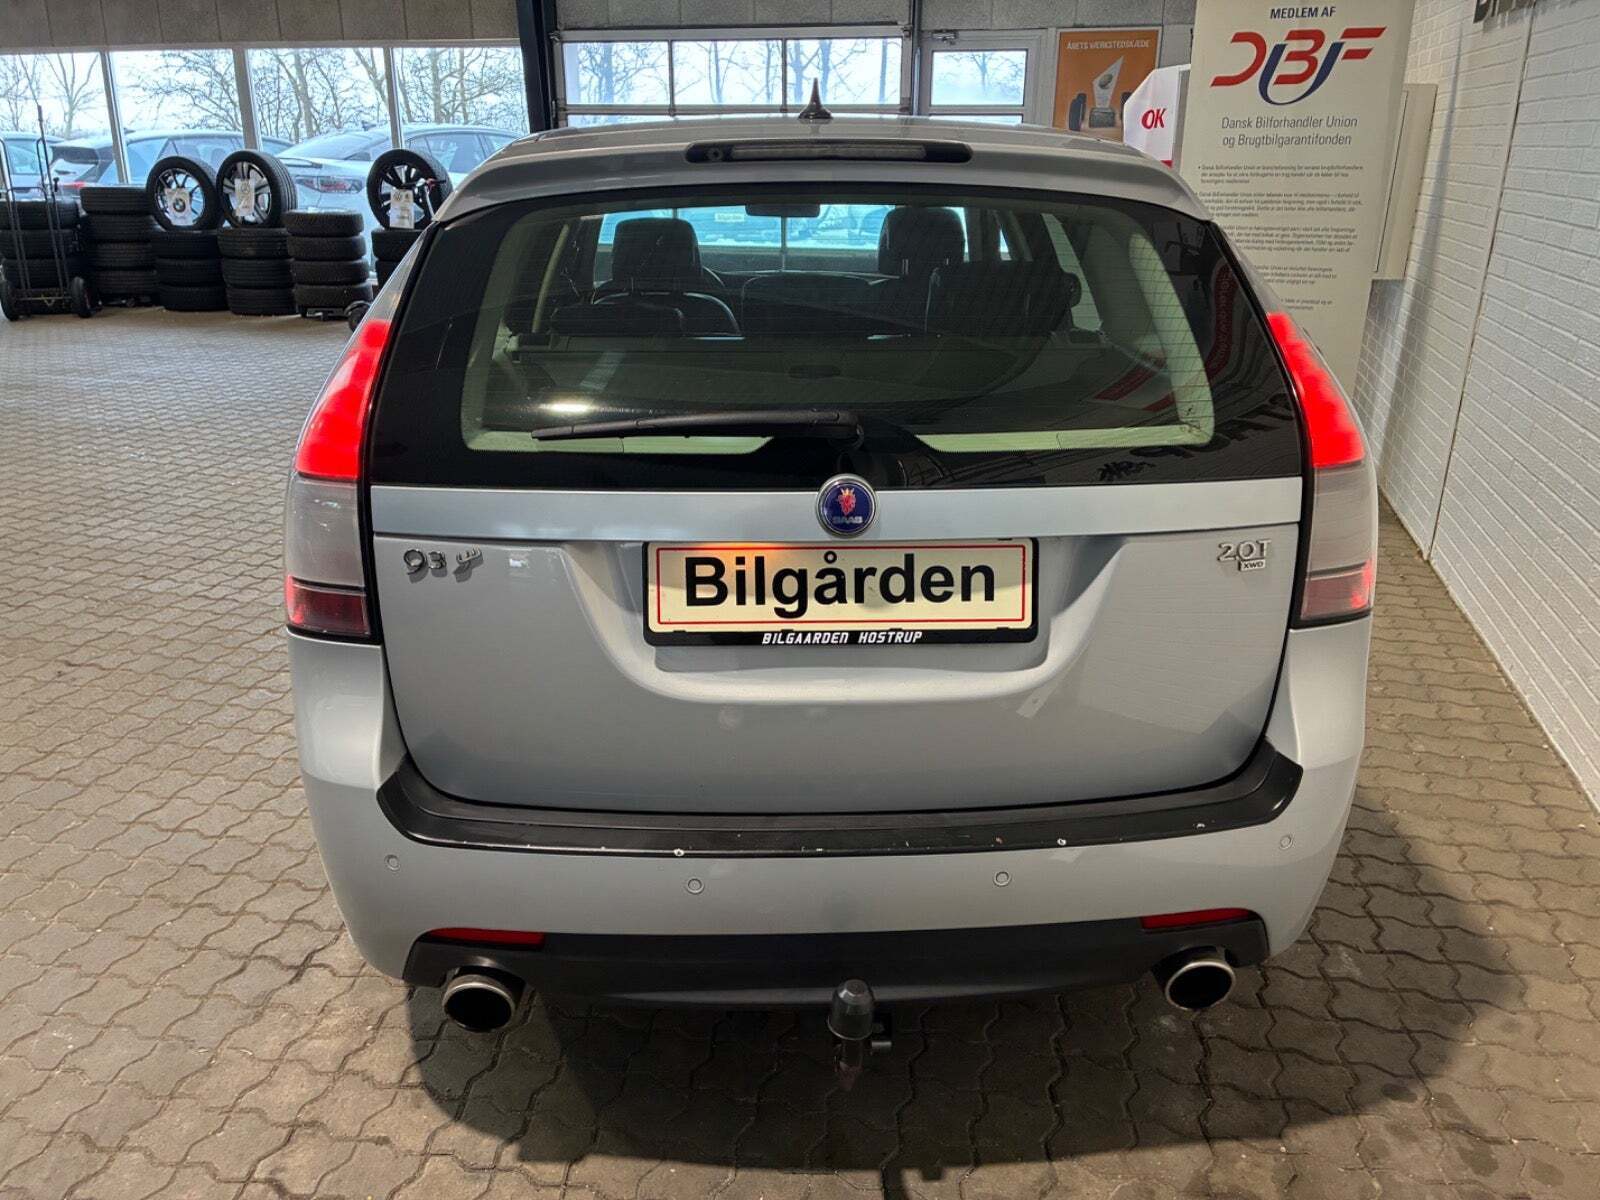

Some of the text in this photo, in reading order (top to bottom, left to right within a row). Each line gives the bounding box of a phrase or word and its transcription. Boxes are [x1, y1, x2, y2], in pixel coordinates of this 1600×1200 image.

[1270, 6, 1336, 19] MEDLEM AF
[1141, 108, 1166, 130] OK
[1221, 115, 1358, 129] Dansk Bilforhandler Union
[1222, 133, 1352, 148] og Brugtbilgarantifonden
[685, 551, 995, 619] Bilgården
[762, 631, 923, 645] BILGAARDEN HOSTRUP
